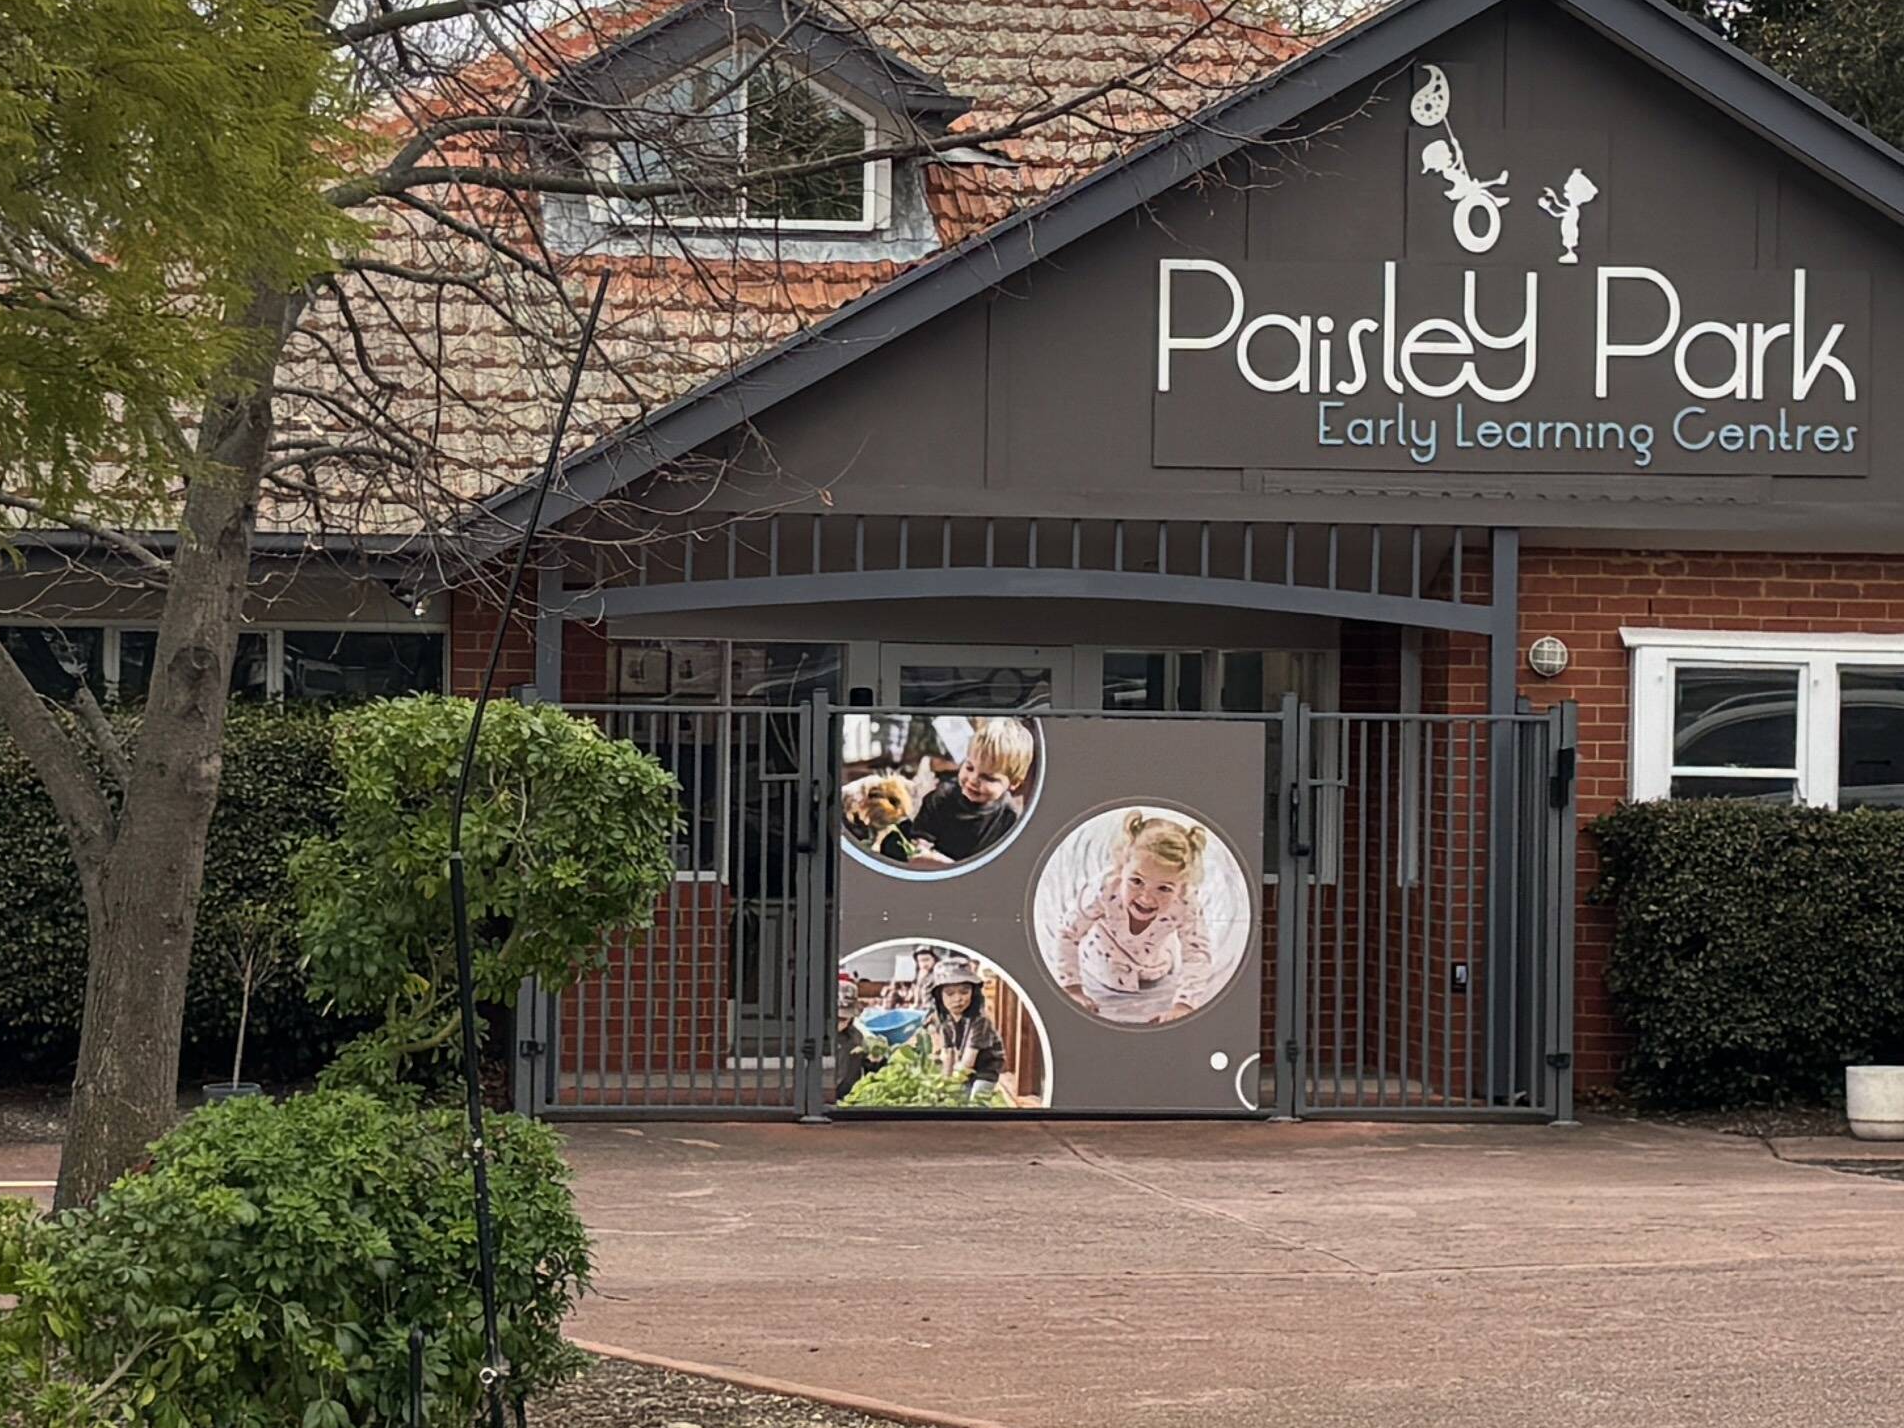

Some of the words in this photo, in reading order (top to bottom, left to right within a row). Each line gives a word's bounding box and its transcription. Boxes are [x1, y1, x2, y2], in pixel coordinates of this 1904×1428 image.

[1157, 257, 1539, 403] Paisley
[1594, 265, 1857, 402] Park
[1317, 399, 1438, 464] Early
[1455, 402, 1655, 467] Learning
[1672, 405, 1859, 455] Centres
